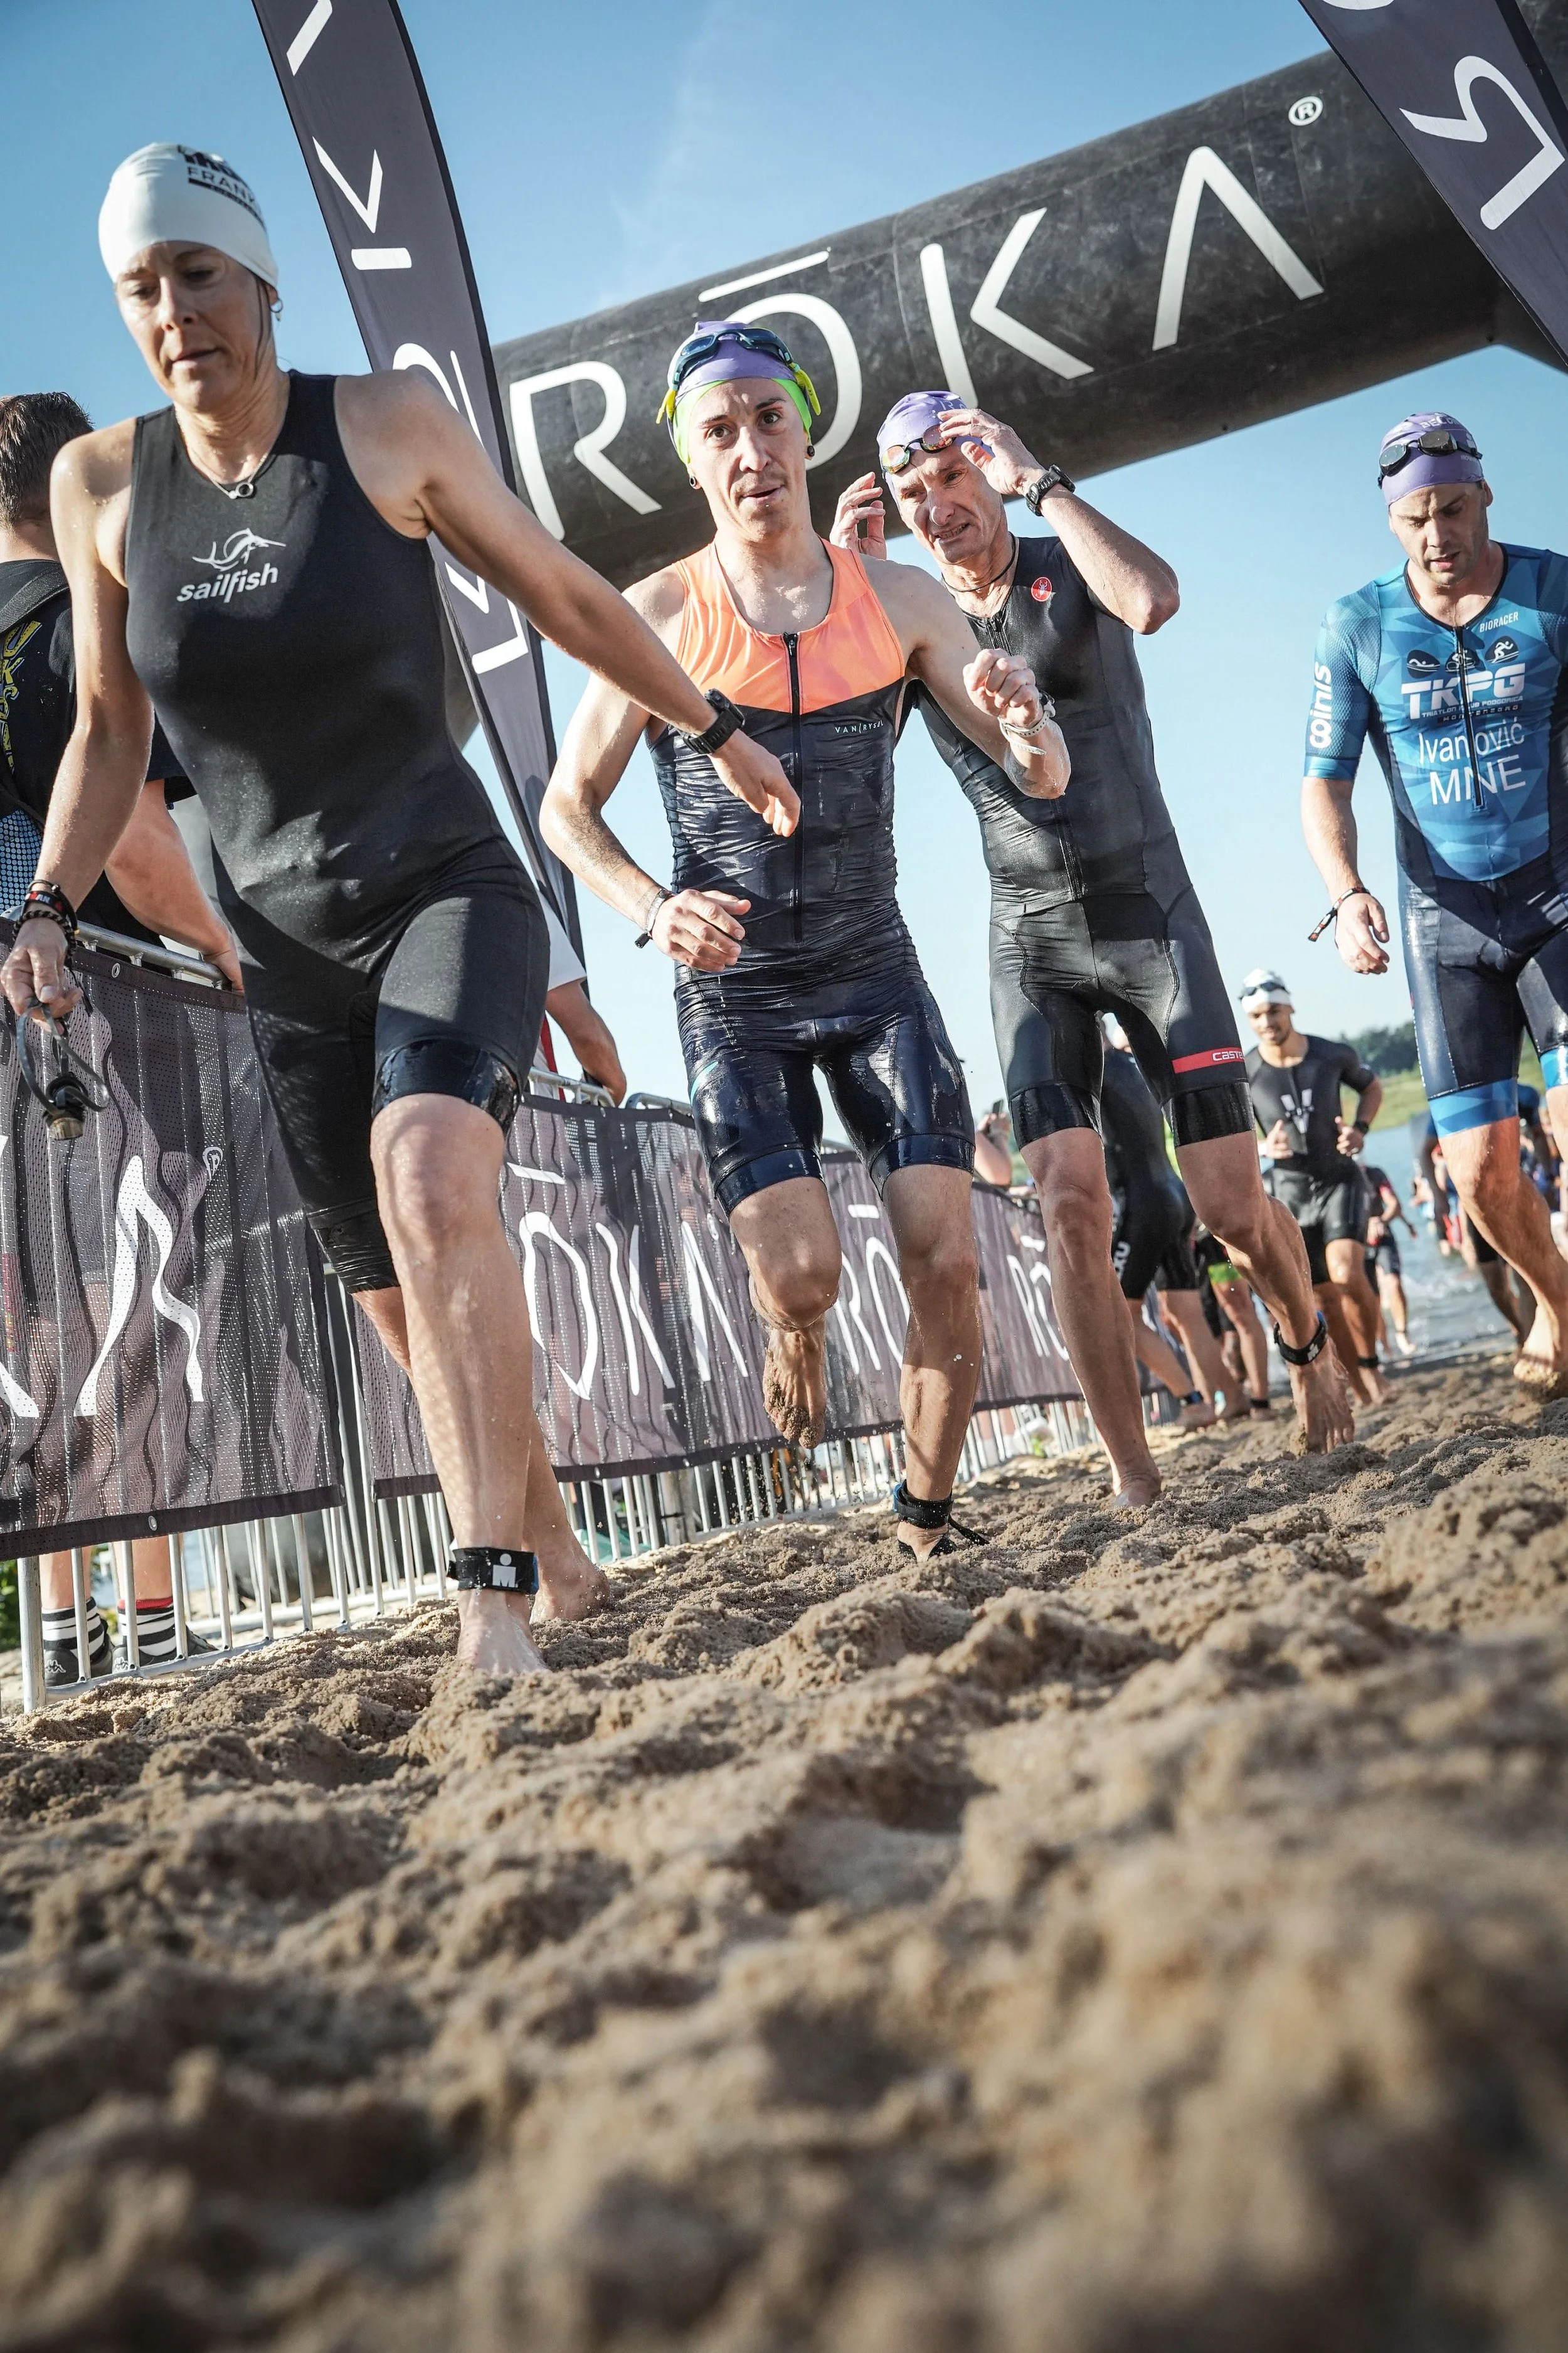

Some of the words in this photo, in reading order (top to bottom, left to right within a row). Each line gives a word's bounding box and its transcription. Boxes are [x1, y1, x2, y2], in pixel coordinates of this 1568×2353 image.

[176, 563, 279, 603] sailfish
[1479, 611, 1519, 633] BIORACER
[1401, 662, 1526, 720] TKPG
[1421, 706, 1456, 718] TRIATLON
[1481, 695, 1523, 706] PODGORICA
[1418, 716, 1525, 765] Ivanović
[1429, 754, 1526, 805] MNE
